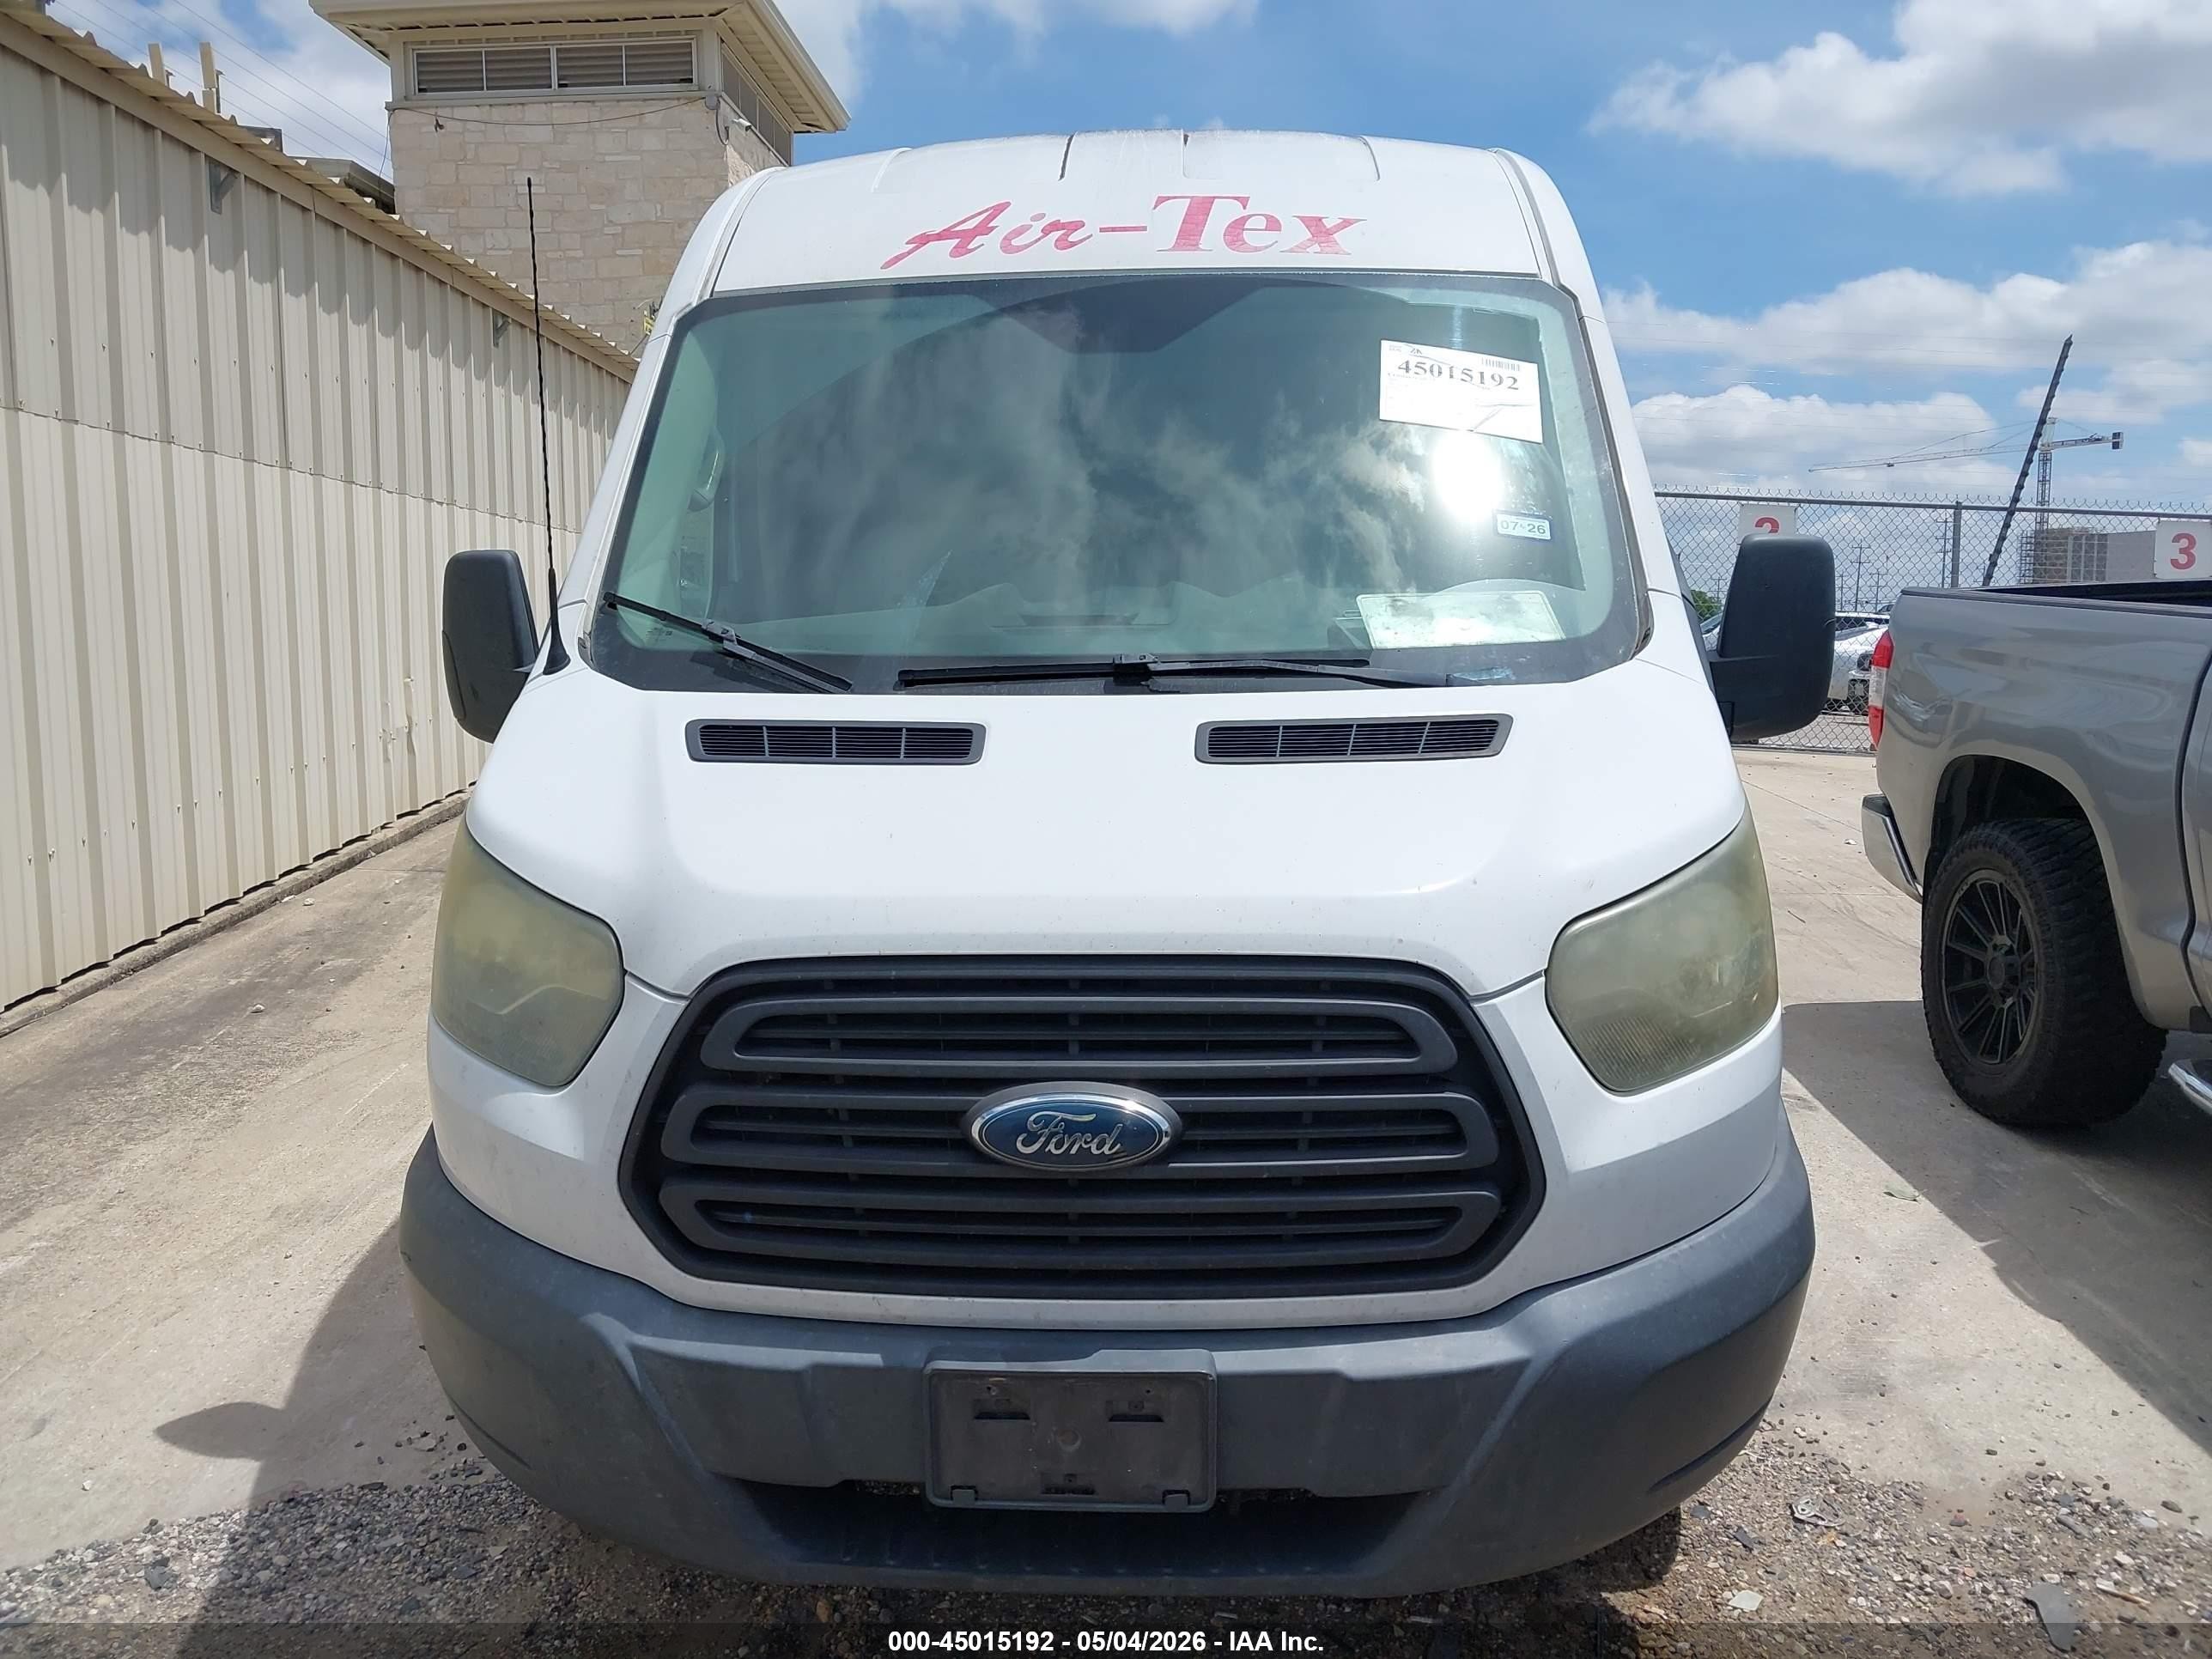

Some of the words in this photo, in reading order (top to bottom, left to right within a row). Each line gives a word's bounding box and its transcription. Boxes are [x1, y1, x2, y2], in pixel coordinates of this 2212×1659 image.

[880, 195, 1367, 270] Air-Tex
[1397, 359, 1520, 391] 45015192
[2170, 532, 2196, 569] 3
[1016, 1110, 1121, 1155] Ford
